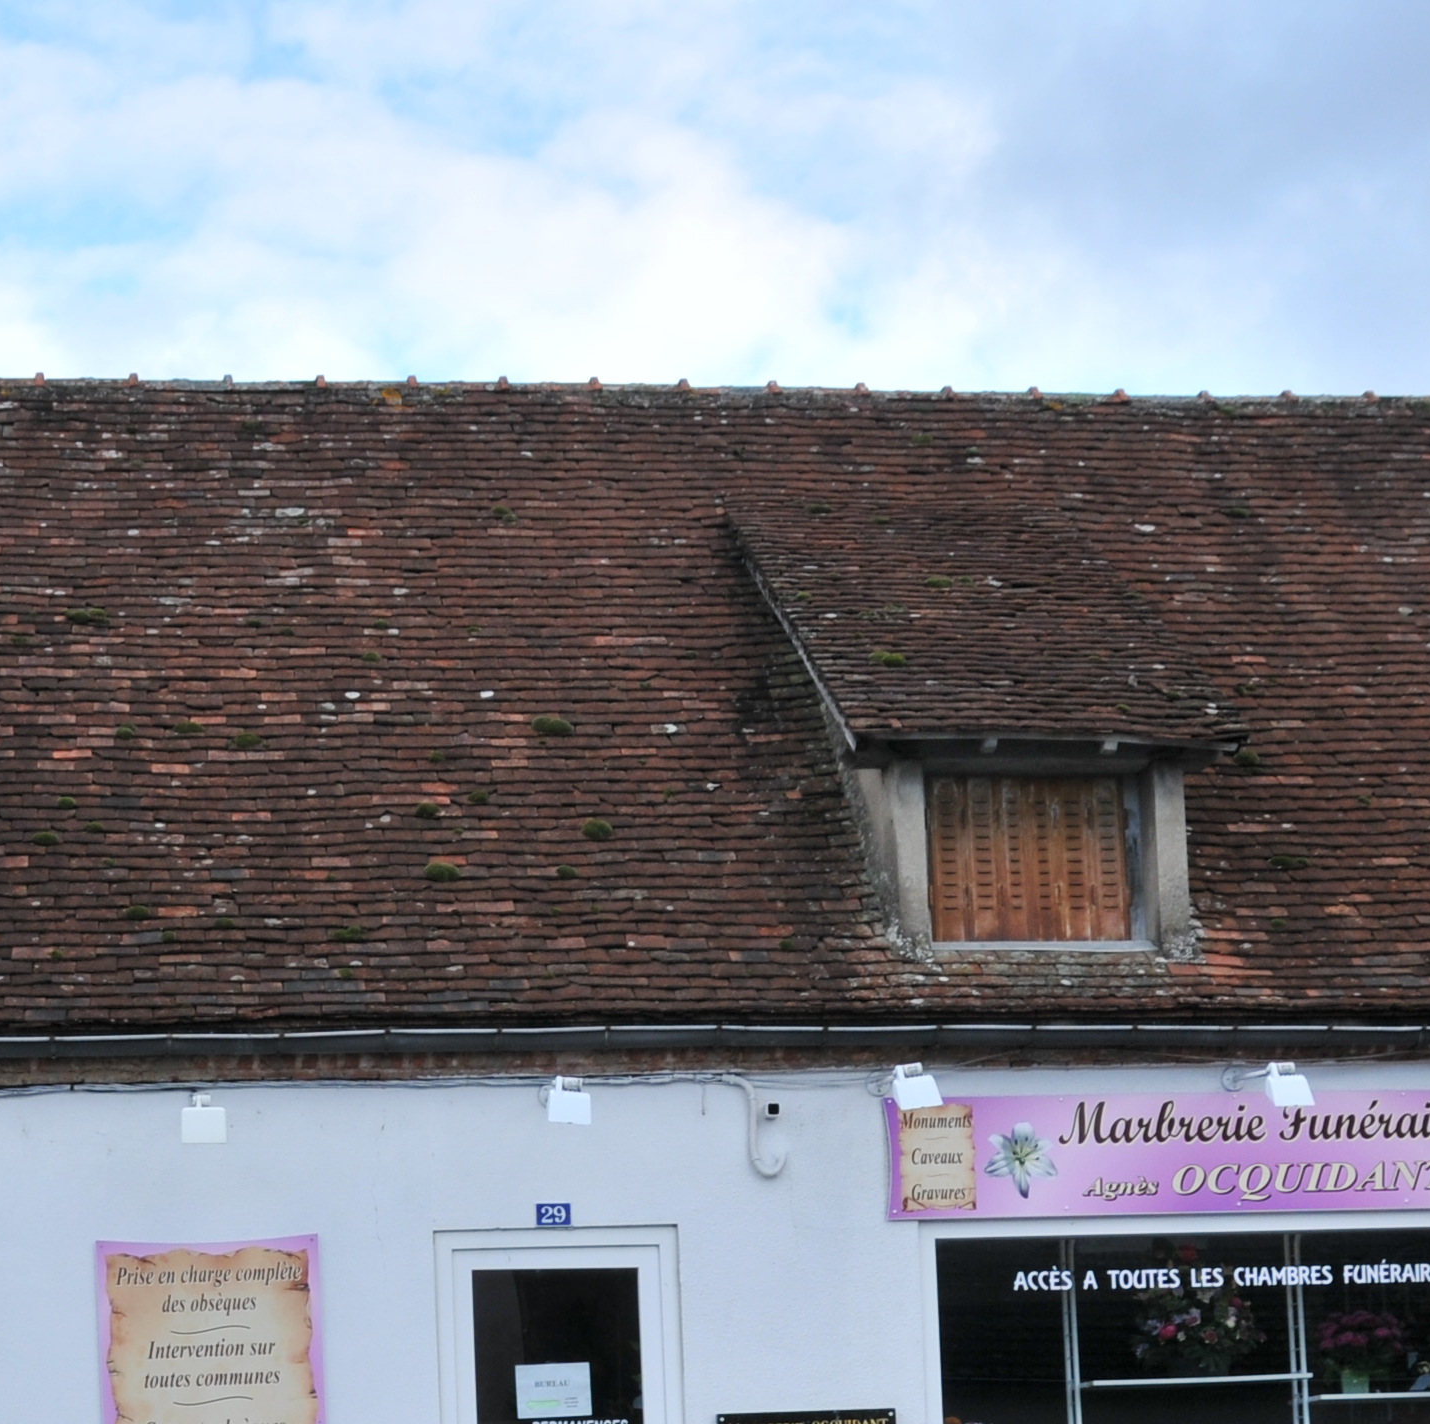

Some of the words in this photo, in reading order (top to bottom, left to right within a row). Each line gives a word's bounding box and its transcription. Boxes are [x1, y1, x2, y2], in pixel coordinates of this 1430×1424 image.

[901, 1111, 972, 1129] Monuments
[1059, 1100, 1266, 1144] Marbrerie
[911, 1148, 963, 1165] Caveaux
[911, 1184, 966, 1201] Gravures
[1083, 1176, 1159, 1201] Agnès
[540, 1205, 567, 1224] 29
[116, 1266, 153, 1286] Prise
[158, 1269, 176, 1284] en
[180, 1263, 231, 1289] charge
[235, 1261, 302, 1288] complète
[1013, 1265, 1072, 1291] ACCÈS
[1083, 1270, 1098, 1290] A
[1108, 1269, 1180, 1290] TOUTES
[1190, 1267, 1224, 1288] LES
[1233, 1265, 1333, 1287] CHAMBRES
[161, 1295, 185, 1313] des
[190, 1293, 257, 1317] obsèques
[148, 1339, 245, 1360] Intervention
[250, 1340, 276, 1356] sur
[144, 1372, 191, 1389] toutes
[196, 1370, 280, 1388] communes
[534, 1379, 571, 1388] BUREAU
